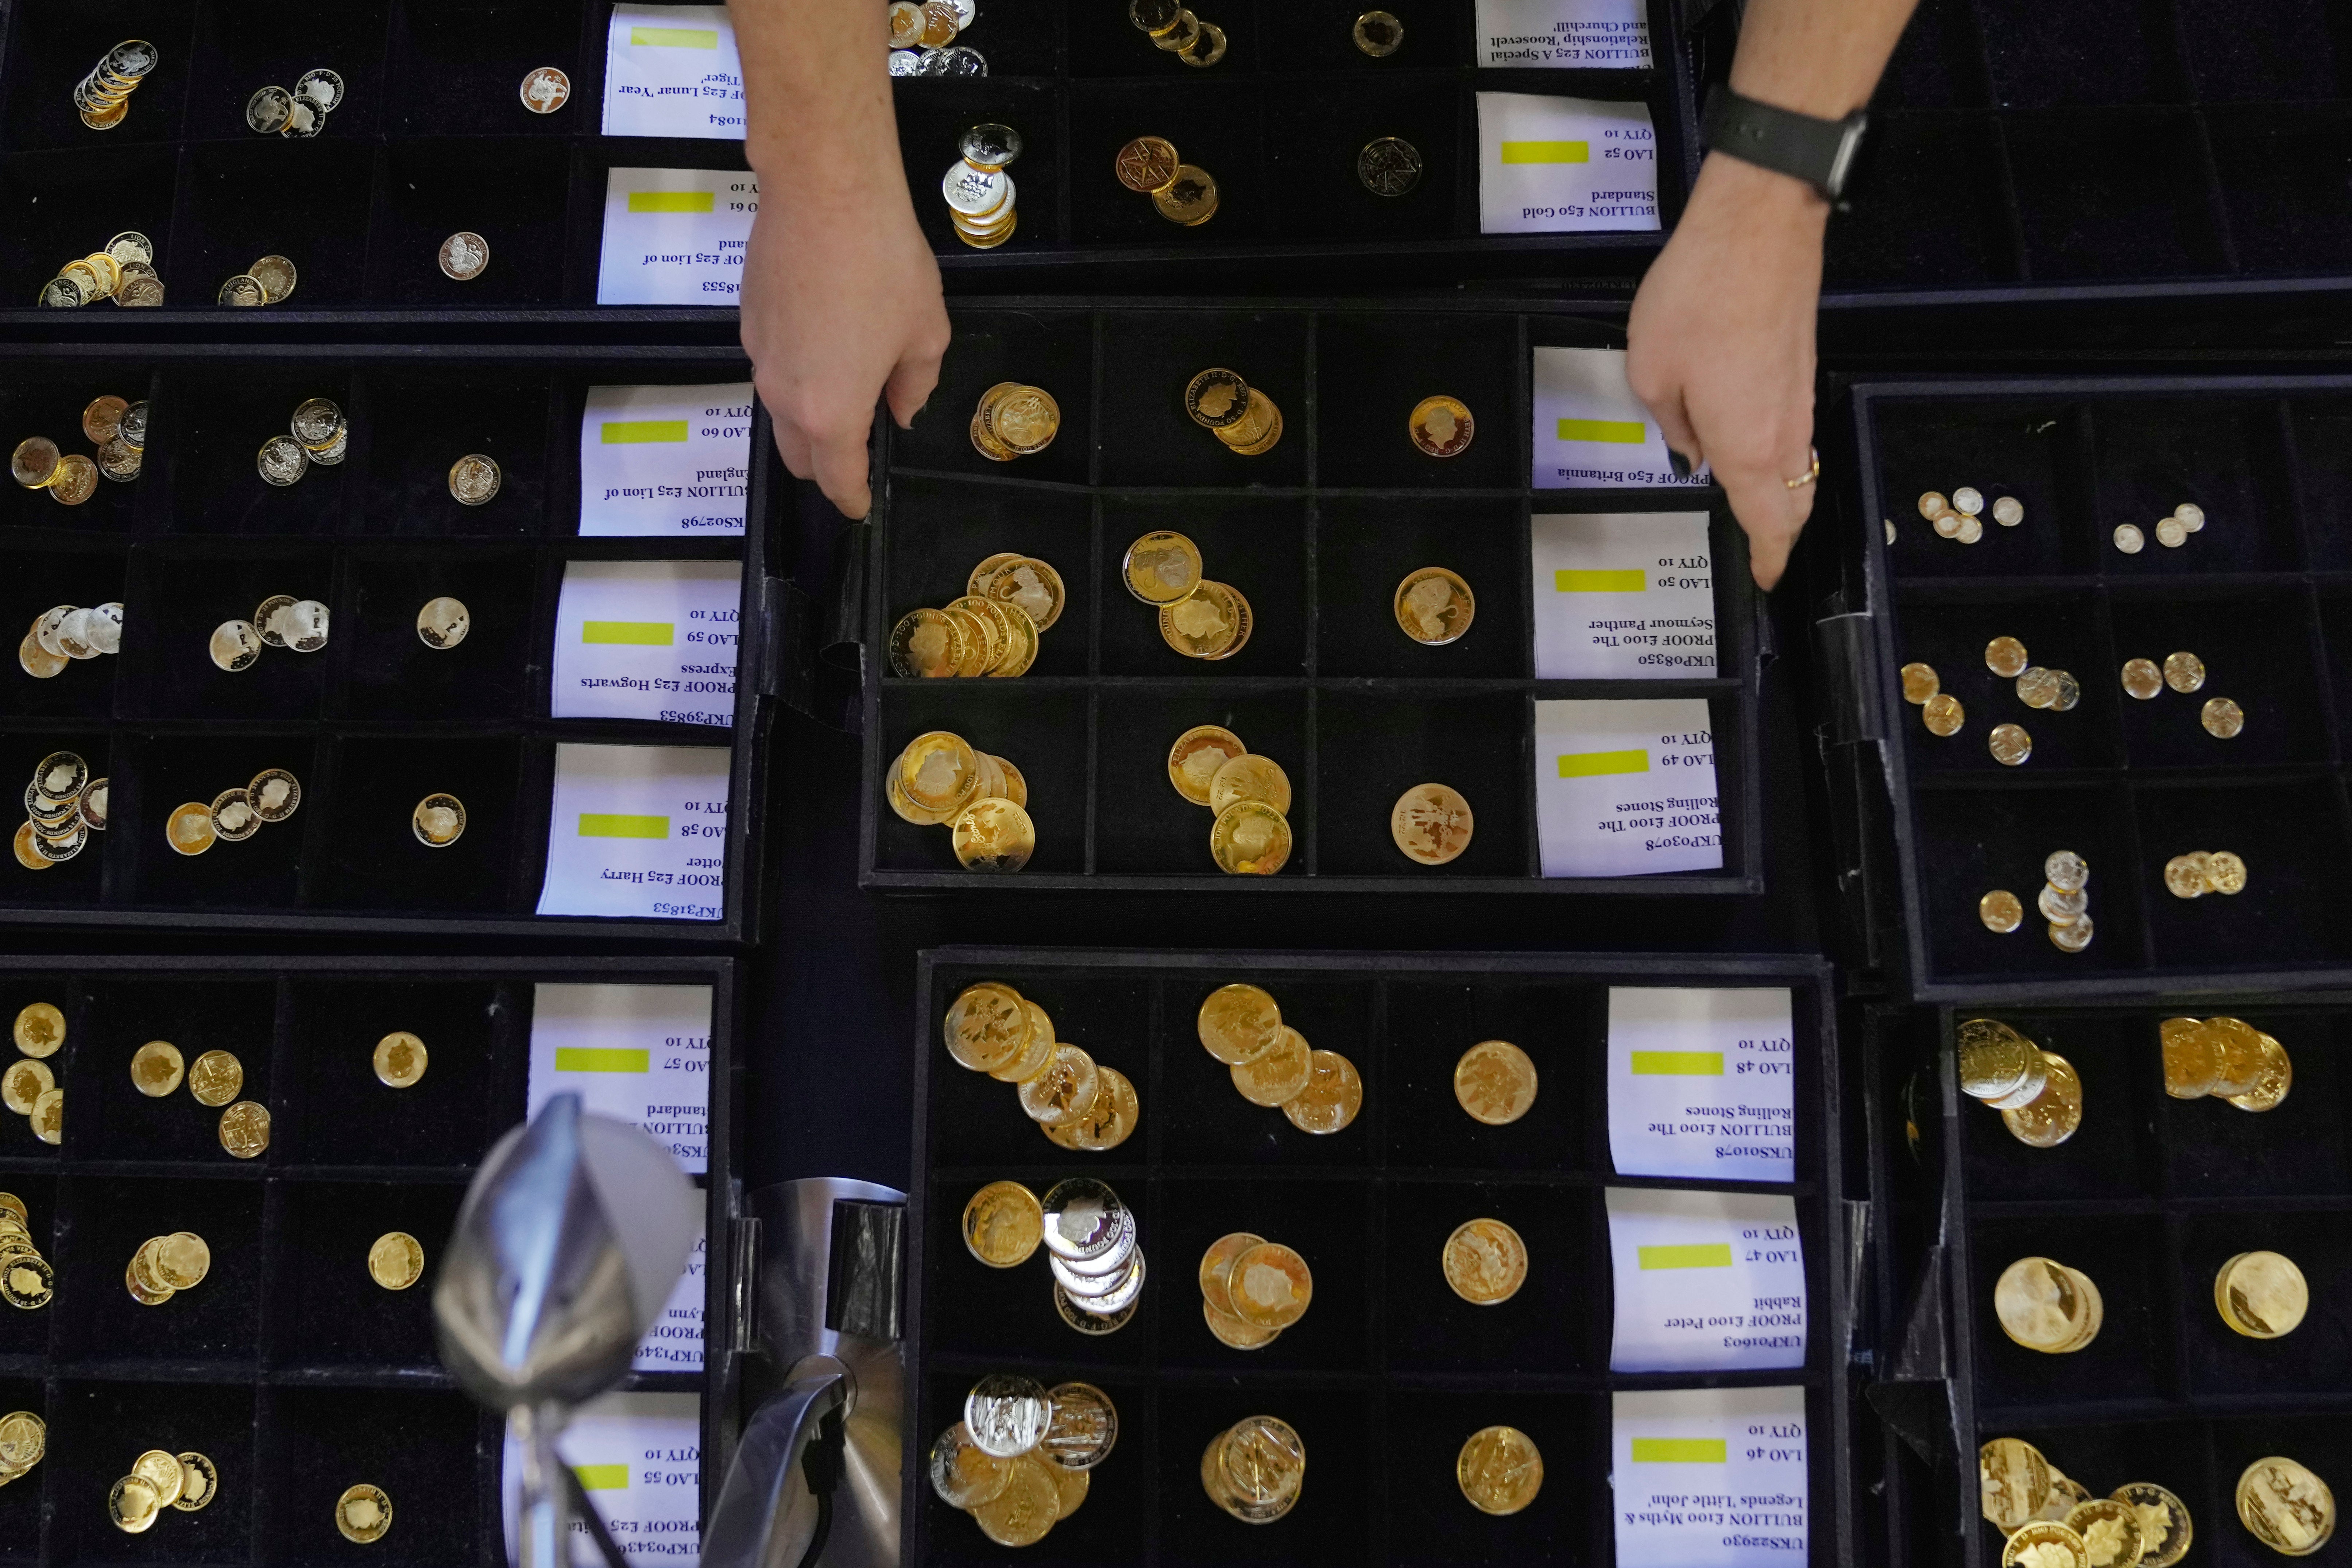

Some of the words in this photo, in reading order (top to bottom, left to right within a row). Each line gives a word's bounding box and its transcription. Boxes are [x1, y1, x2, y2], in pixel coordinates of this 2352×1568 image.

[1622, 22, 1647, 32] and
[1490, 36, 1559, 48] 'Roosevelt
[1564, 34, 1648, 46] Relationship
[1491, 49, 1539, 62] Special
[1541, 50, 1552, 60] A
[1556, 48, 1580, 59] £25
[1585, 49, 1649, 59] BULLION
[701, 73, 740, 86] Tiger'
[619, 86, 653, 97] 'Year
[658, 87, 698, 97] Lunar
[1605, 130, 1619, 138] 10
[1624, 128, 1652, 140] QTY
[1605, 148, 1620, 158] 52
[1624, 150, 1653, 160] LAO
[731, 184, 745, 193] 10
[1591, 191, 1654, 202] Standard
[730, 203, 743, 212] 61
[1523, 208, 1554, 218] Gold
[1559, 205, 1584, 217] £50
[1589, 205, 1655, 217] BULLION
[642, 256, 657, 265] of
[662, 255, 691, 265] Lion
[696, 253, 720, 265] £25
[706, 409, 721, 417] 10
[702, 428, 719, 438] 60
[1558, 468, 1624, 482] Britannia
[1628, 471, 1653, 483] £50
[604, 489, 619, 500] of
[623, 488, 653, 499] Lion
[658, 485, 682, 498] £25
[682, 516, 745, 529] KS02798
[1659, 558, 1674, 567] 10
[1678, 556, 1708, 568] QTY
[1659, 577, 1675, 587] 50
[1679, 578, 1709, 589] LAO
[690, 611, 706, 619] 10
[709, 609, 739, 622] QTY
[1589, 620, 1645, 631] Panther
[1650, 617, 1713, 630] Seymour
[688, 631, 704, 643] 59
[708, 634, 739, 645] LAO
[1593, 636, 1619, 647] The
[1624, 635, 1657, 646] £100
[1662, 635, 1713, 646] PROOF
[1638, 654, 1714, 667] UKP08350
[681, 663, 735, 677] Express
[581, 677, 650, 691] Hogwarts
[654, 679, 680, 692] £25
[684, 681, 735, 693] PROOF
[1662, 735, 1676, 744] 10
[1681, 731, 1711, 744] QTY
[1662, 755, 1679, 766] 49
[1683, 754, 1713, 766] LAO
[685, 802, 700, 810] 10
[1616, 801, 1664, 813] Stones
[1666, 797, 1717, 810] Rolling
[1598, 820, 1625, 832] The
[1629, 817, 1663, 829] £100
[1668, 813, 1719, 827] PROOF
[682, 824, 699, 837] 58
[1645, 834, 1721, 851] UKP03078
[600, 869, 644, 883] Harry
[648, 871, 673, 884] £25
[677, 874, 722, 886] ROOF
[666, 1037, 682, 1046] 10
[1739, 1039, 1753, 1049] 10
[1758, 1038, 1790, 1052] QTY
[664, 1057, 681, 1069] 57
[1736, 1060, 1755, 1073] 48
[1759, 1062, 1790, 1074] LAO
[1685, 1107, 1734, 1118] Stones
[1738, 1104, 1791, 1119] Rolling
[1648, 1123, 1675, 1135] The
[1680, 1123, 1715, 1135] £100
[1720, 1124, 1791, 1136] BULLION
[1715, 1145, 1792, 1158] UKS01078
[1743, 1230, 1758, 1239] 10
[1763, 1226, 1794, 1240] QTY
[1745, 1249, 1761, 1262] 47
[1766, 1250, 1797, 1263] LAO
[1753, 1297, 1801, 1310] Rabbit
[1664, 1318, 1703, 1329] Peter
[1708, 1316, 1744, 1327] £100
[1748, 1314, 1801, 1327] PROOF
[1748, 1425, 1764, 1435] 10
[1769, 1423, 1801, 1437] QTY
[646, 1449, 661, 1460] 10
[666, 1447, 699, 1461] QTY
[1746, 1446, 1765, 1461] 46
[1769, 1449, 1802, 1461] LAO
[645, 1471, 661, 1483] 55
[1740, 1494, 1803, 1509] Legends
[1624, 1513, 1634, 1525] &
[1639, 1510, 1683, 1525] Myths
[1688, 1513, 1724, 1524] £100
[1729, 1513, 1803, 1526] BULLION
[611, 1520, 639, 1533] £25
[644, 1521, 698, 1533] PROOF
